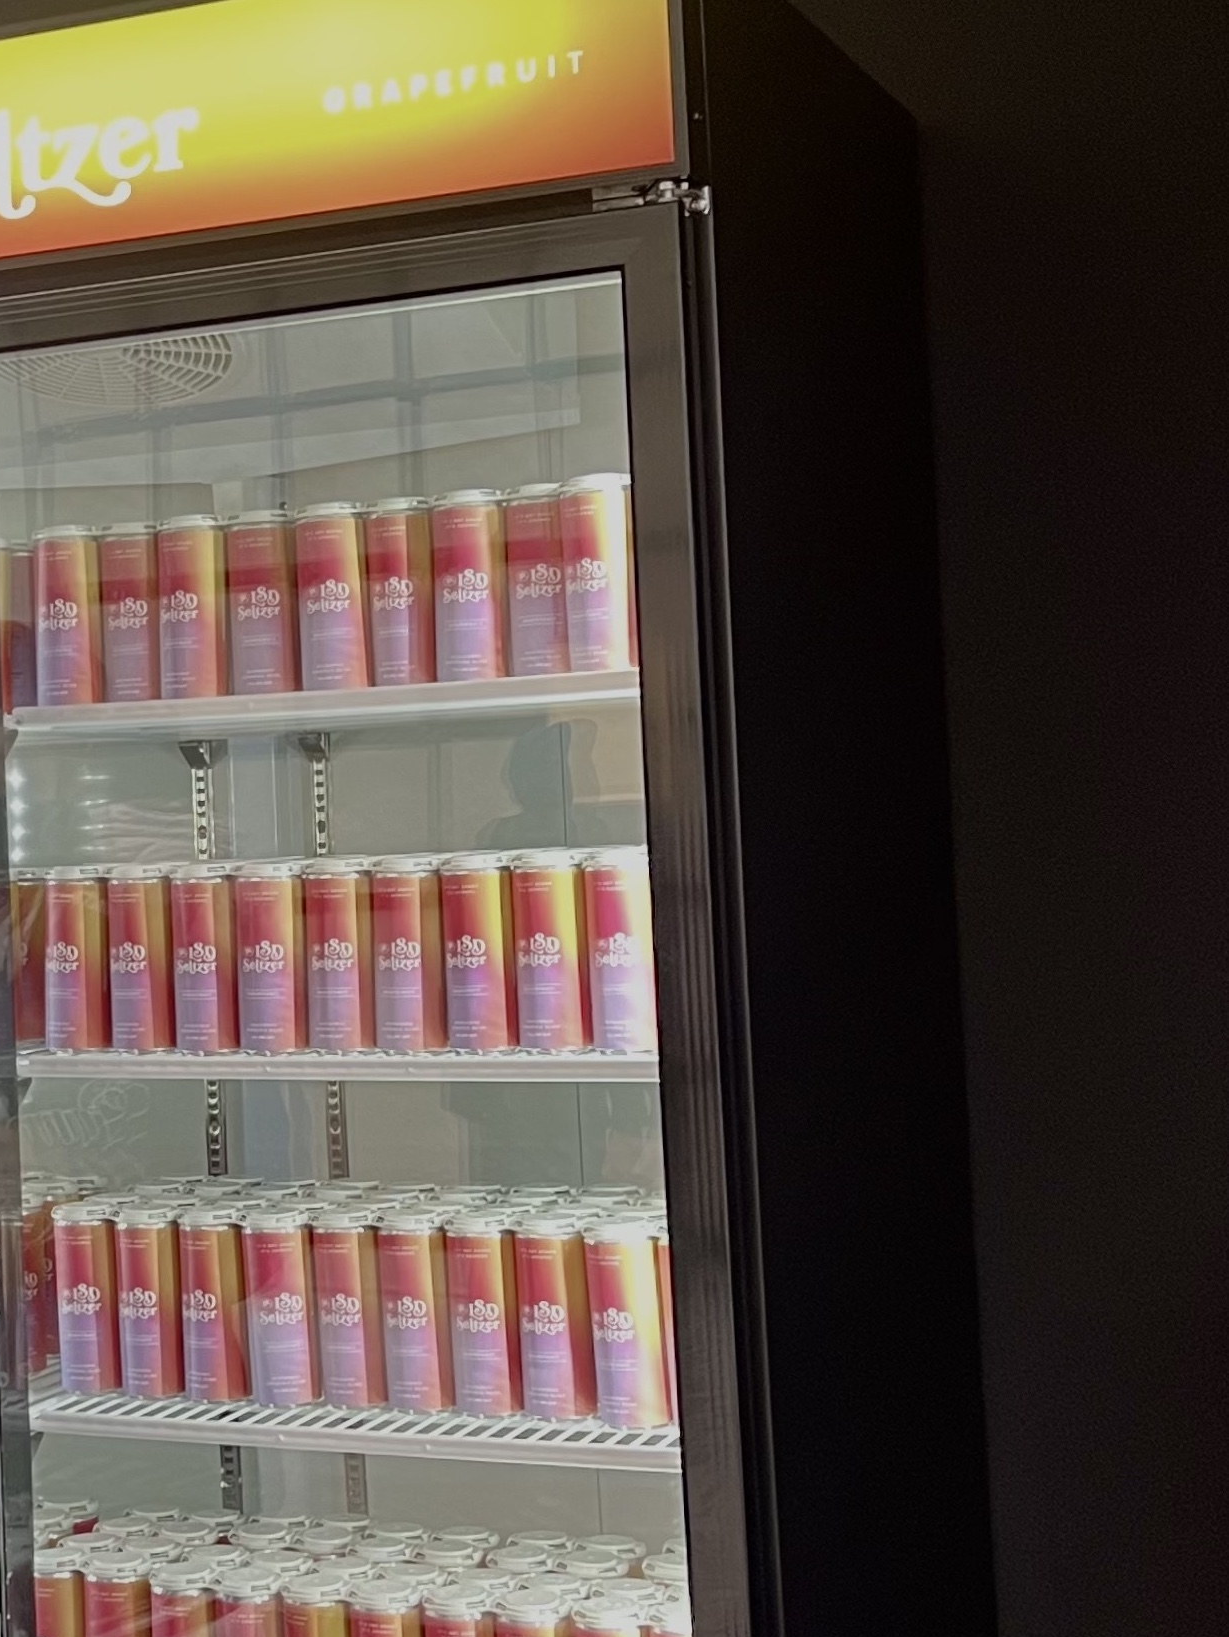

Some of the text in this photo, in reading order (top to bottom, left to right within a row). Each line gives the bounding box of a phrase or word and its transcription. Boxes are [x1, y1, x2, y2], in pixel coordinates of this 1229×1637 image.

[322, 50, 584, 113] GRAPEFRUIT
[531, 564, 561, 584] LSD
[576, 558, 608, 580] LSD
[320, 579, 350, 599] LSD
[385, 576, 414, 597] LSD
[458, 569, 488, 590] LSD
[171, 590, 198, 610] LSD
[251, 586, 280, 607] LSD
[443, 587, 489, 603] Seltzer
[515, 583, 562, 599] Seltzer
[50, 598, 77, 618] LSD
[238, 605, 281, 621] Seltzer
[307, 598, 350, 614] Seltzer
[189, 942, 216, 962] LSD
[255, 940, 283, 960] LSD
[324, 938, 353, 958] LSD
[391, 937, 420, 958] LSD
[457, 935, 486, 956] LSD
[530, 932, 560, 956] LSD
[243, 958, 284, 973] Seltzer
[73, 1283, 101, 1303] LSD
[274, 1292, 303, 1312] LSD
[331, 1293, 359, 1313] LSD
[398, 1296, 427, 1316] LSD
[469, 1299, 499, 1320] LSD
[534, 1301, 565, 1322] LSD
[603, 1307, 634, 1328] LSD
